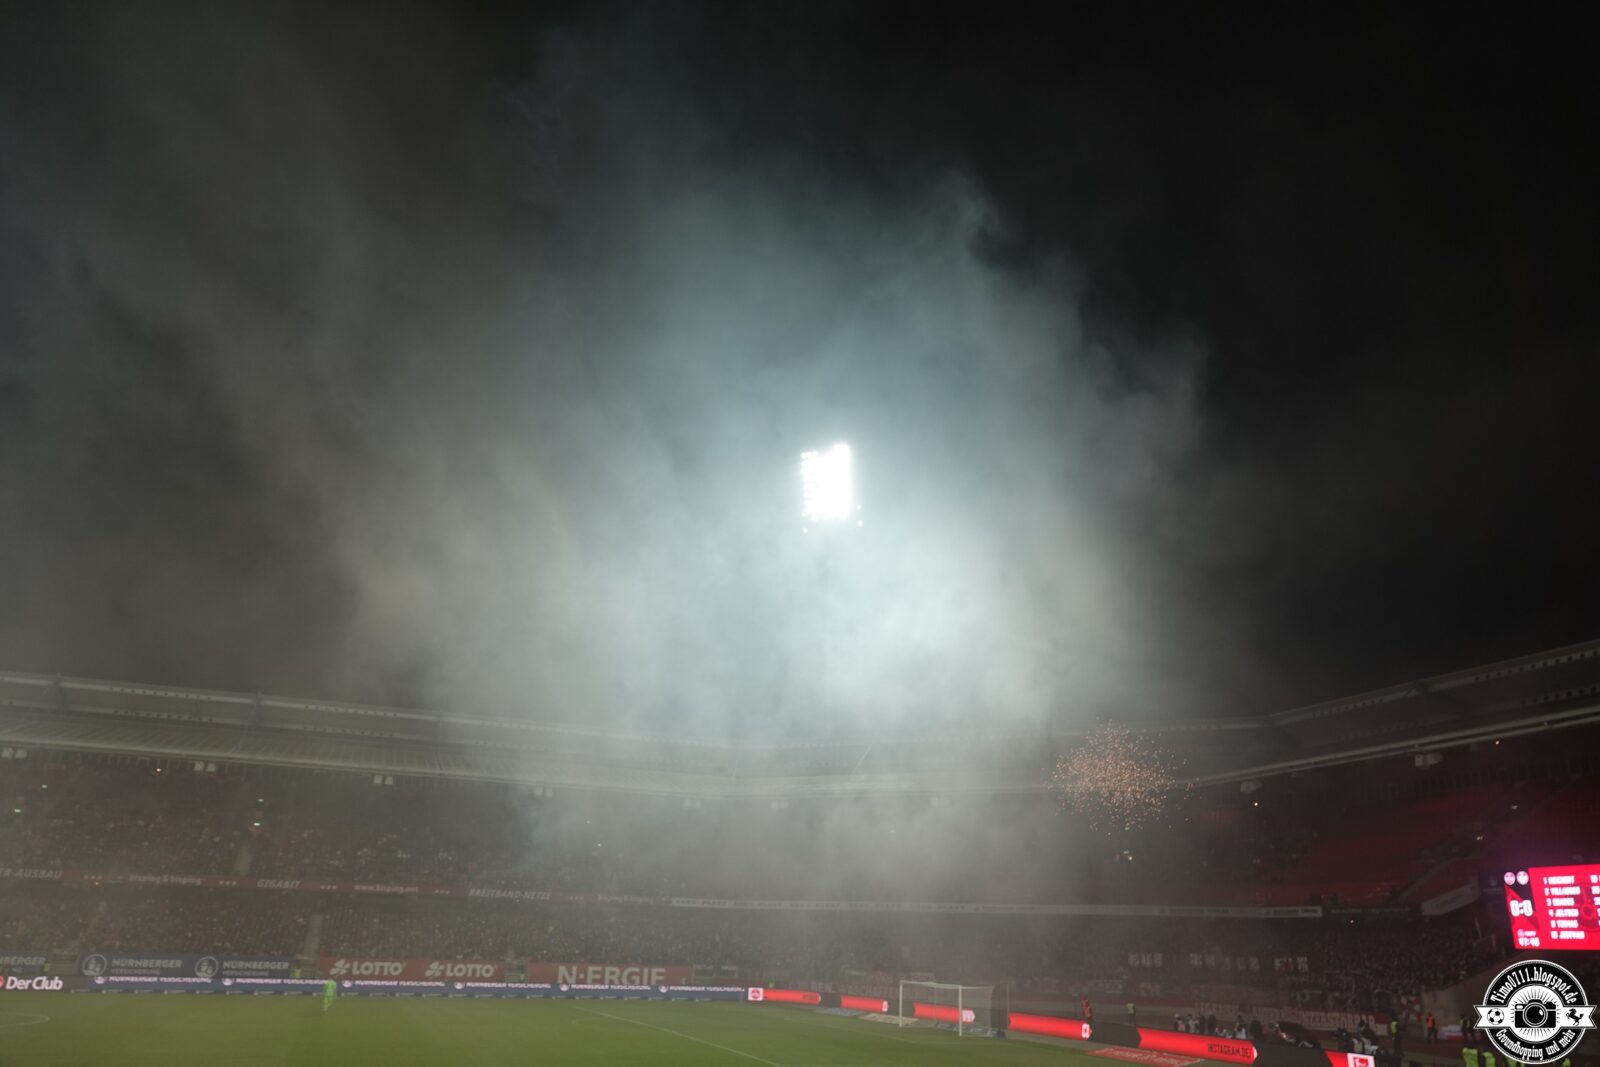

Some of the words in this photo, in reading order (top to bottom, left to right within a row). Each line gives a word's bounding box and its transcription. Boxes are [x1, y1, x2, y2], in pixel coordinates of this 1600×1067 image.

[256, 879, 301, 889] GIGABIT
[1510, 899, 1533, 917] 0:0
[111, 958, 184, 969] NÜRNBERGER
[222, 959, 290, 970] NÜRNBERGER
[352, 962, 404, 976] LOTTO
[446, 963, 495, 977] LOTTO
[5, 975, 31, 990] Der
[32, 976, 63, 990] Club
